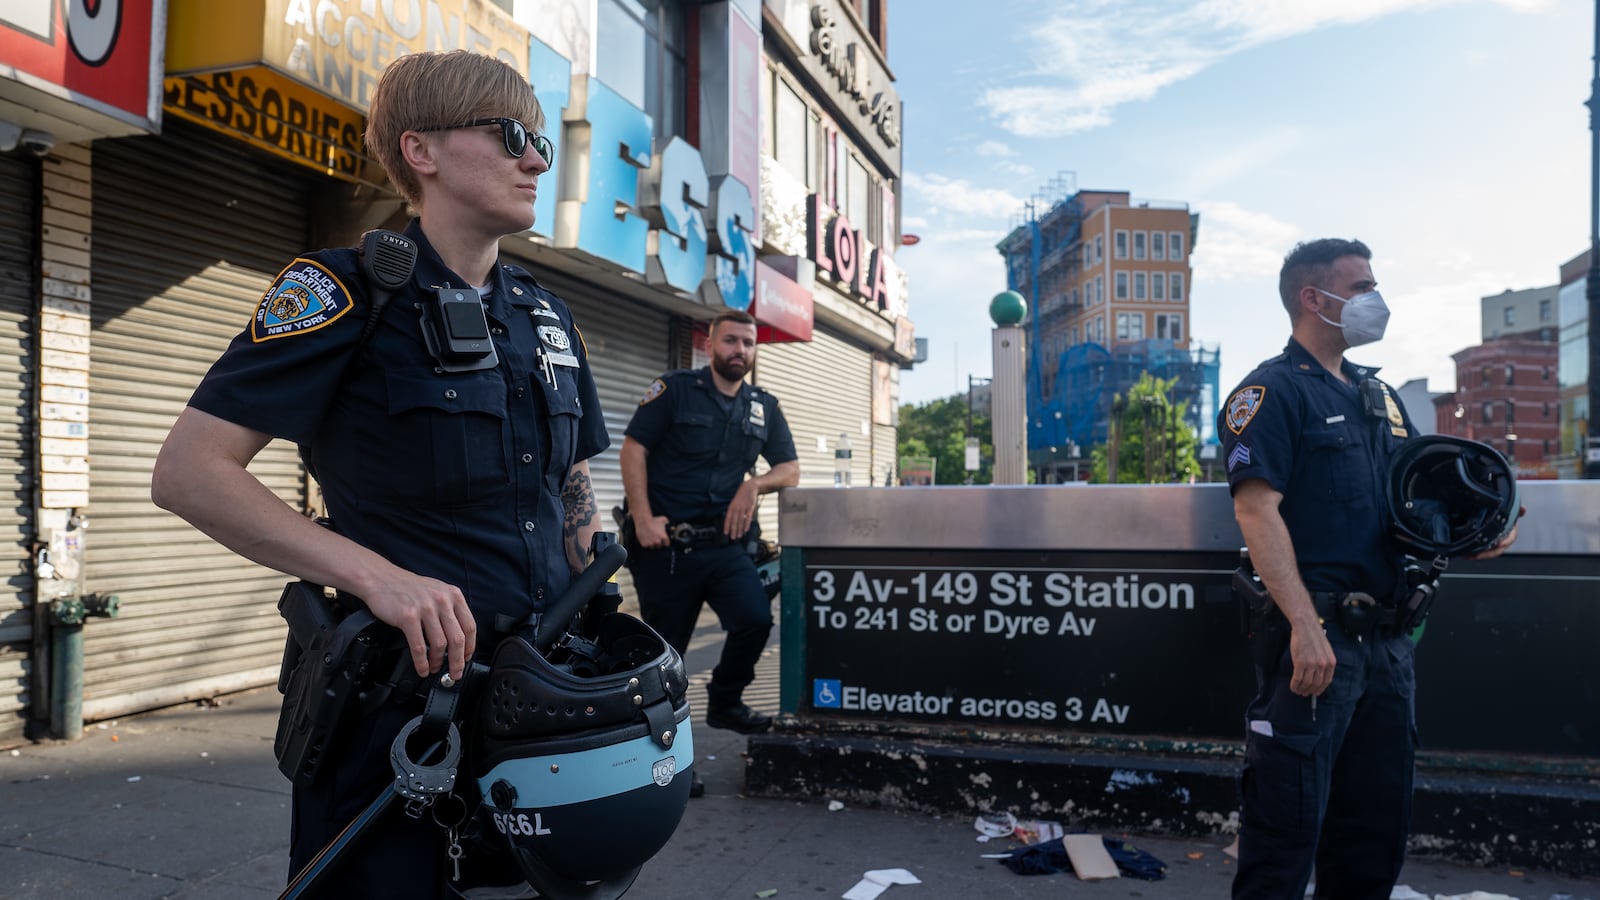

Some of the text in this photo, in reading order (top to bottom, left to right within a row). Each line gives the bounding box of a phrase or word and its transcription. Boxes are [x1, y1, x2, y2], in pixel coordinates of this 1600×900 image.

[389, 236, 409, 248] NYPD
[814, 192, 890, 310] LOLA
[284, 270, 338, 312] DEPARTMENT
[302, 266, 337, 294] POLICE
[256, 286, 276, 322] CITY OF
[268, 313, 327, 335] NEW YORK
[813, 570, 835, 602] 3
[844, 571, 978, 605] Av-149
[989, 572, 1032, 606] St
[1044, 573, 1195, 610] Station
[813, 606, 1096, 640] To 241 St or Dyre Av
[842, 686, 1130, 724] Elevator across 3 Av
